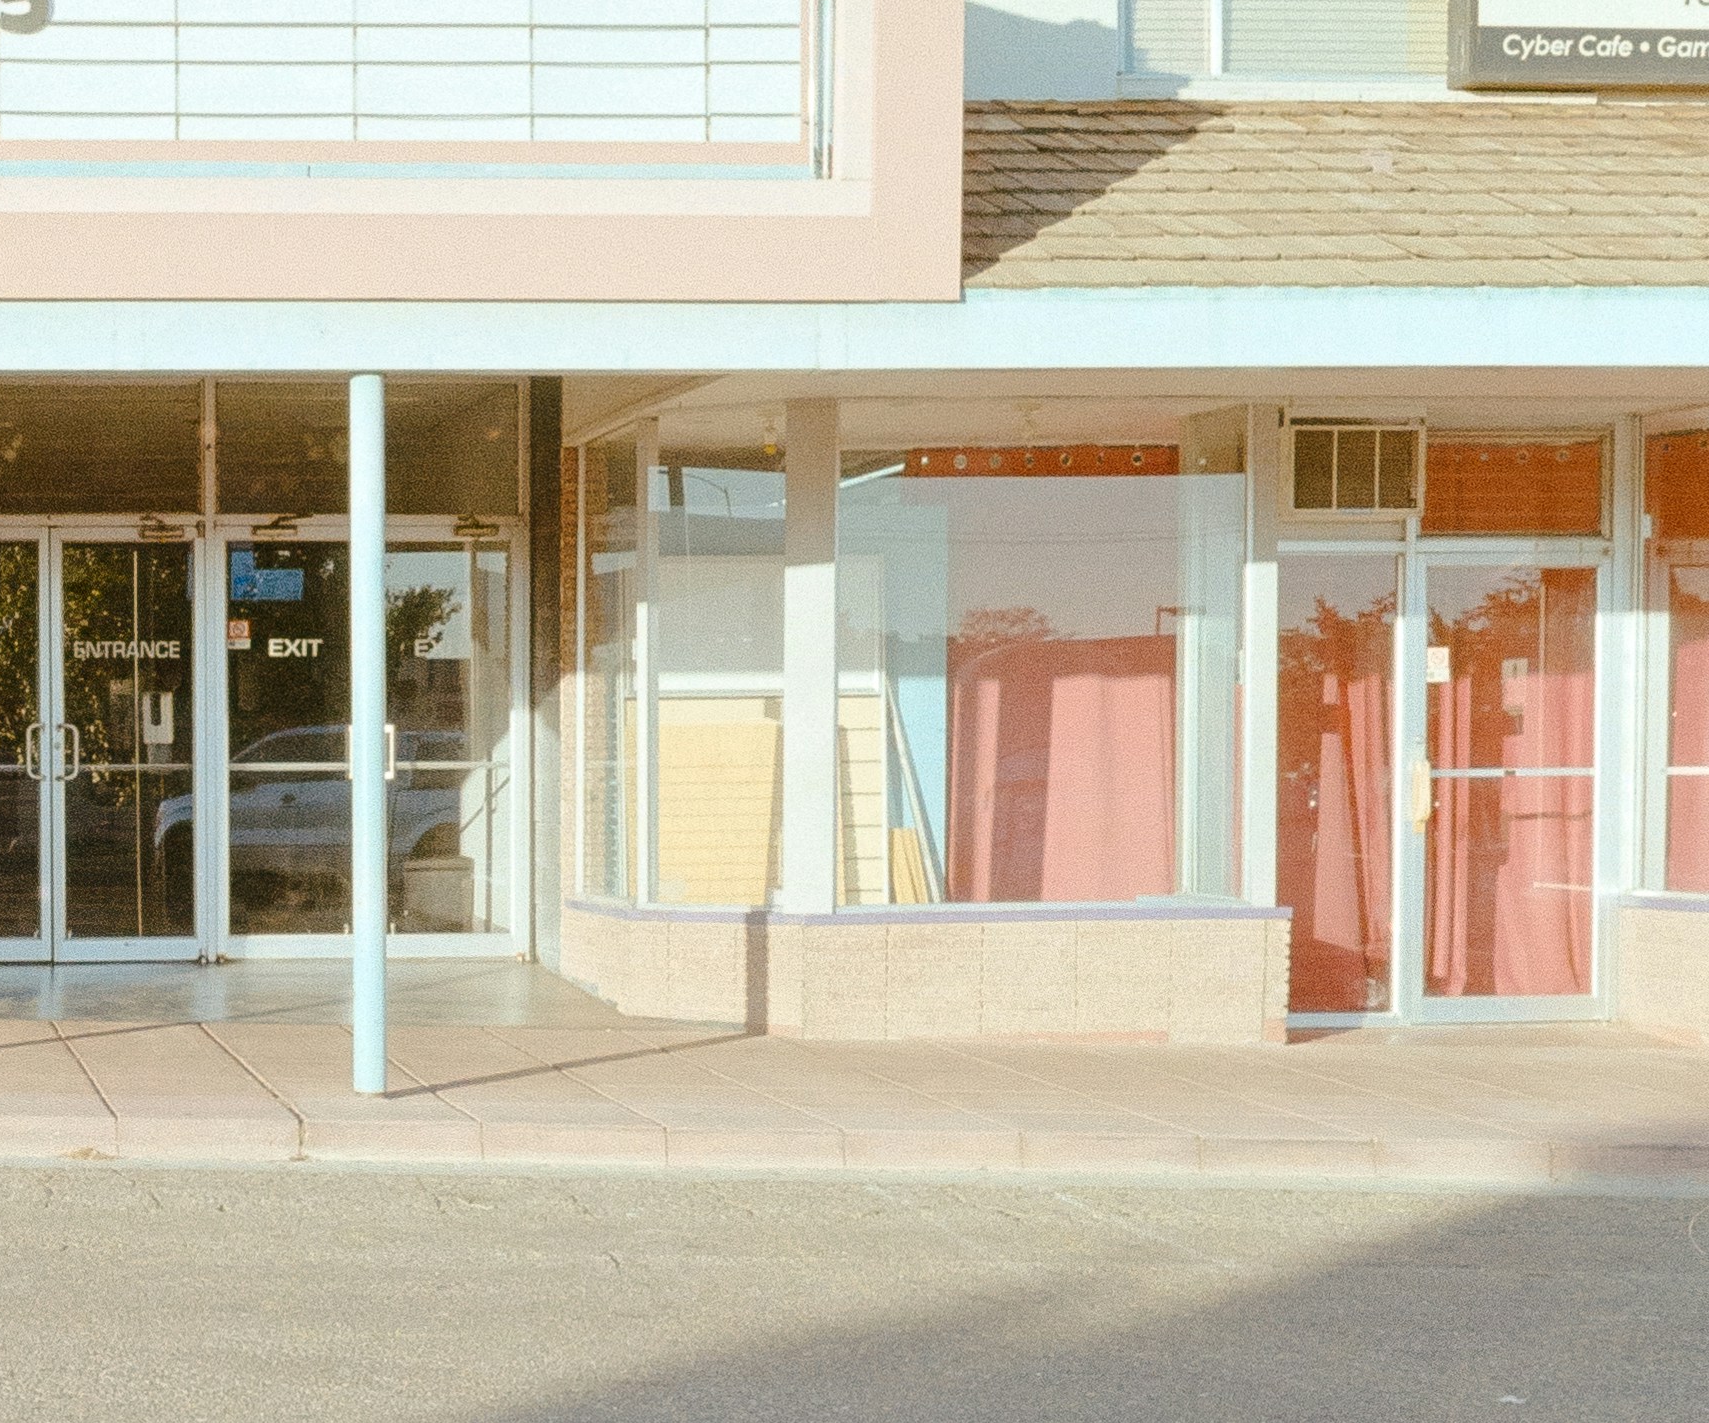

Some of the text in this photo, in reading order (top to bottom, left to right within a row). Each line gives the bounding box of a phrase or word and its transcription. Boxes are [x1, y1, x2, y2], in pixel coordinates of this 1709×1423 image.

[1502, 34, 1574, 61] Cyber
[1578, 35, 1634, 57] Cafe
[73, 640, 181, 658] ENTRANCE
[268, 638, 324, 658] EXIT
